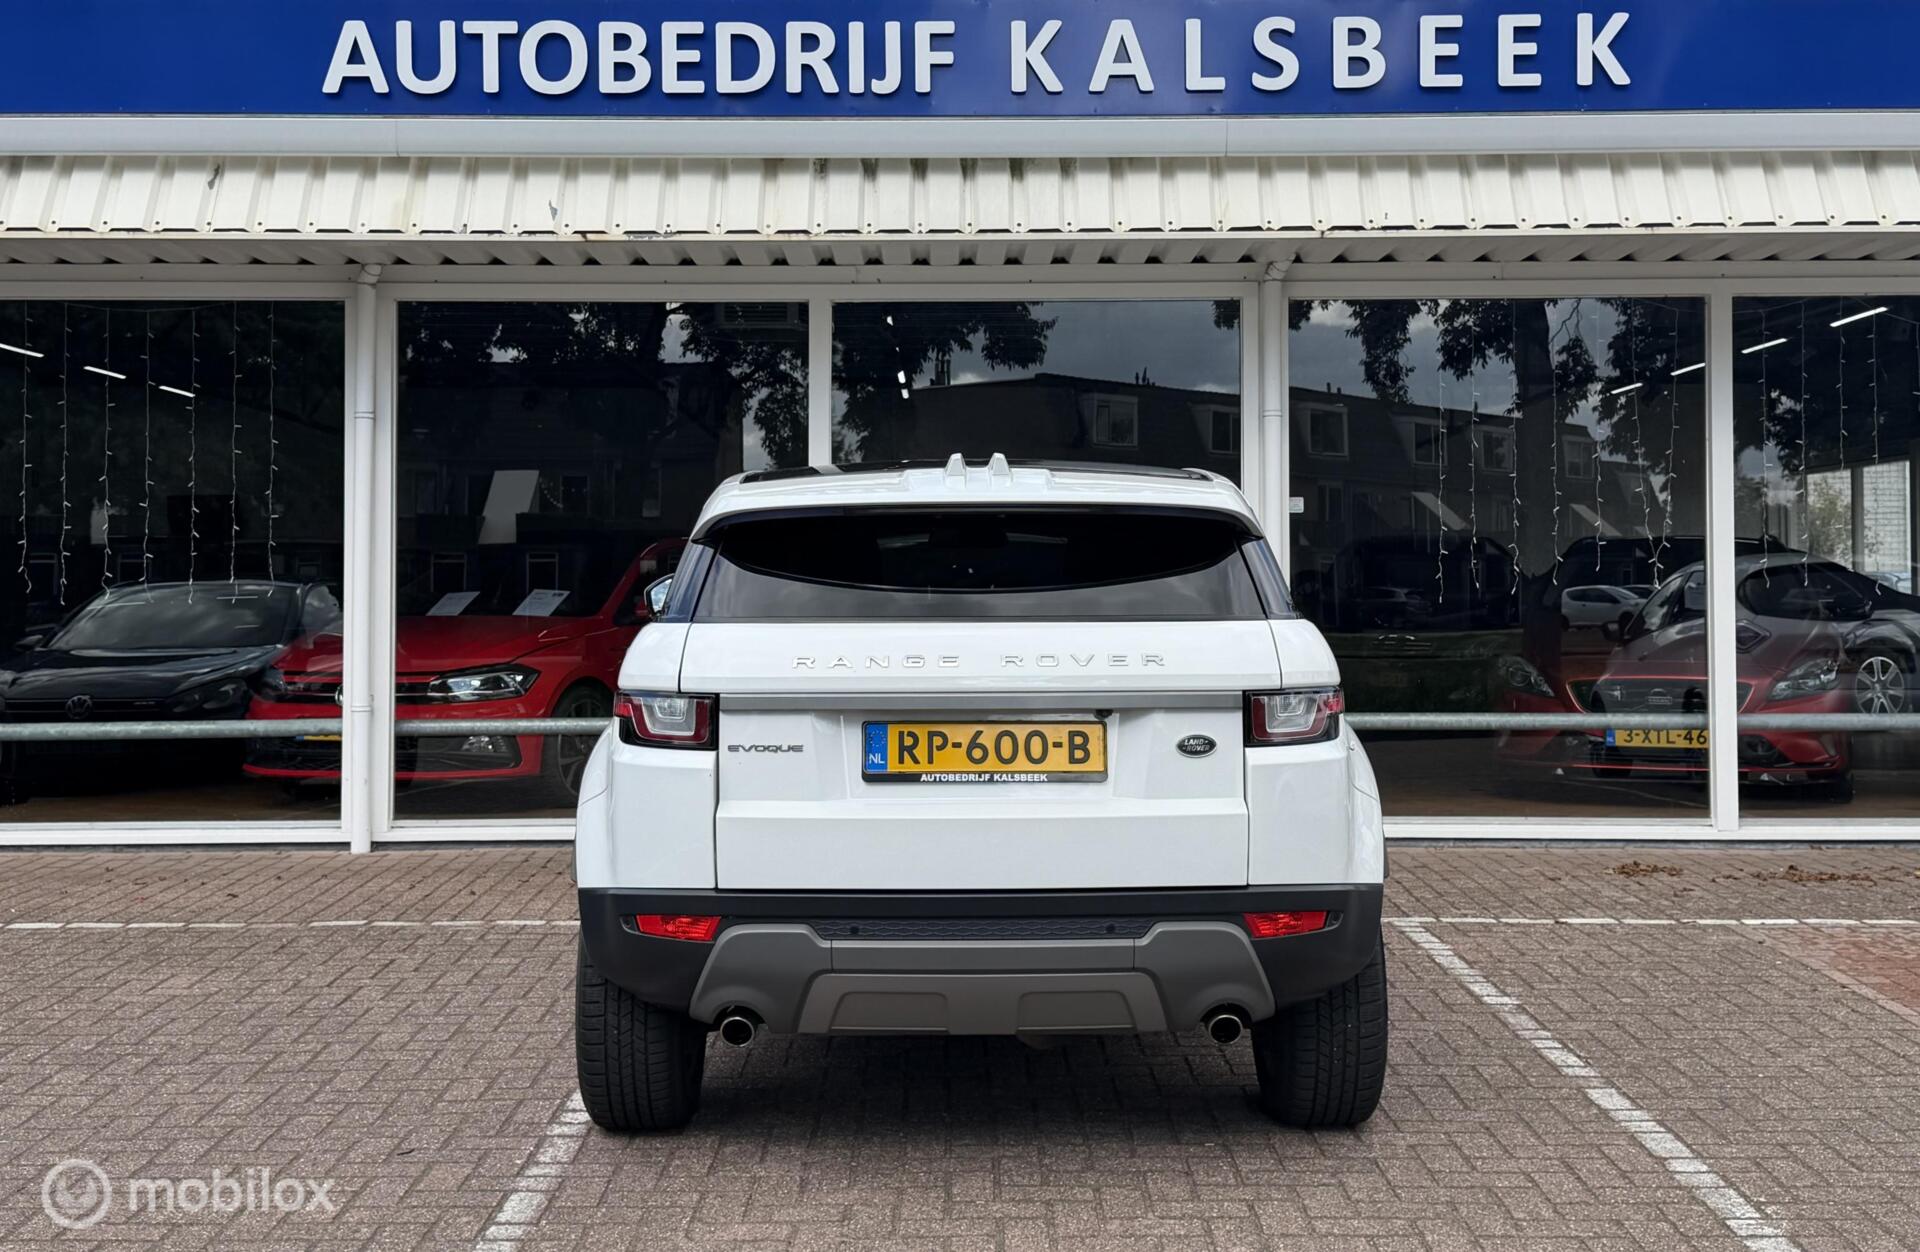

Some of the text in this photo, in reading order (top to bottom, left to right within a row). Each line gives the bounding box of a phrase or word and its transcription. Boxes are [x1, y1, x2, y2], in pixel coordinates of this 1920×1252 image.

[321, 12, 1632, 95] AUTOBEDRIJF KALSBEEK
[792, 653, 1165, 669] RANGE ROVER
[1624, 730, 1707, 745] 3-XTL-46
[727, 744, 804, 753] EVOQUE
[869, 730, 1091, 765] NL RP-600-B
[920, 773, 1048, 782] AUTOBEDRIJF KALSBEEK
